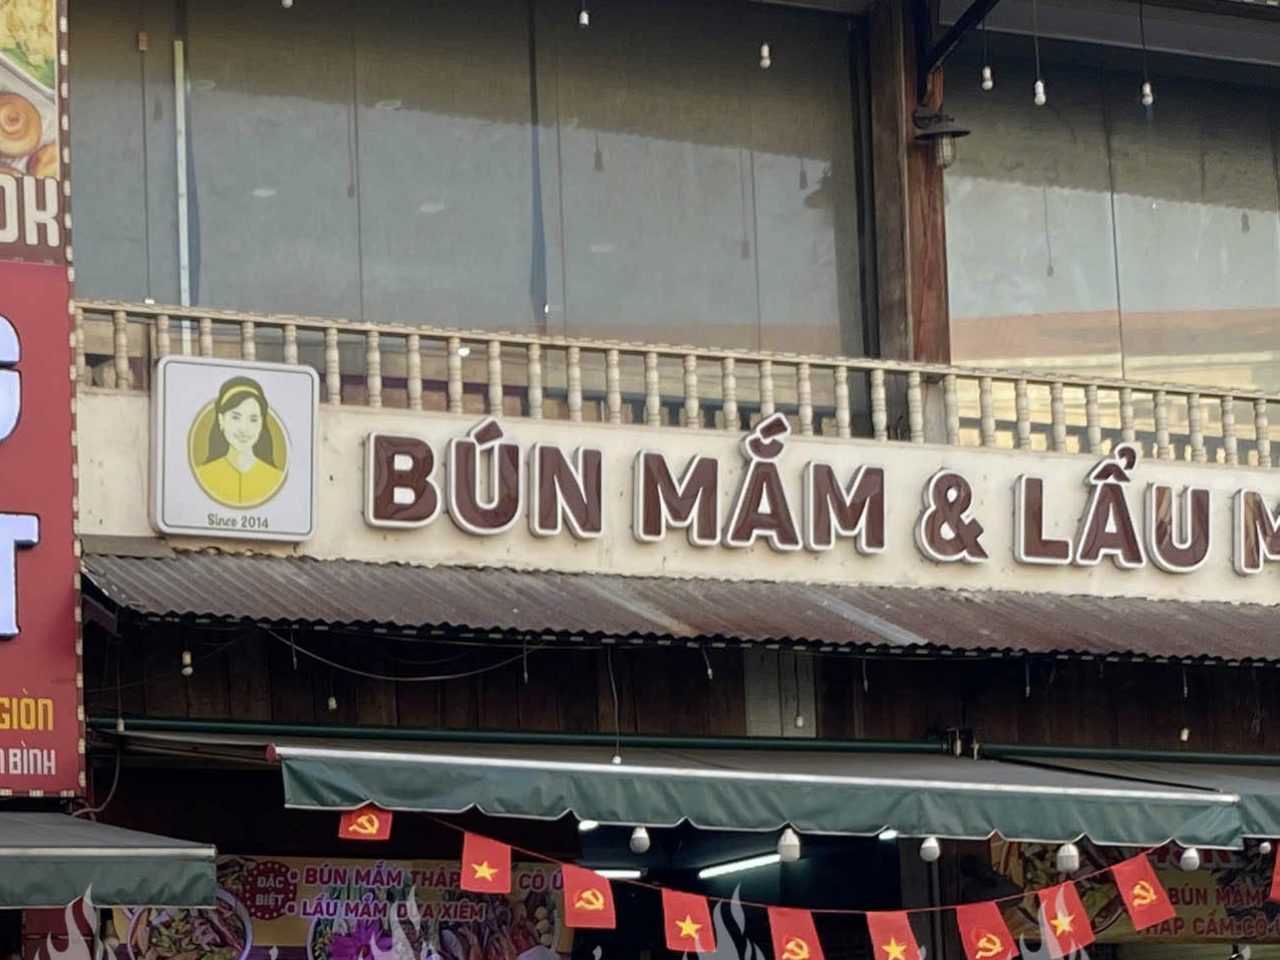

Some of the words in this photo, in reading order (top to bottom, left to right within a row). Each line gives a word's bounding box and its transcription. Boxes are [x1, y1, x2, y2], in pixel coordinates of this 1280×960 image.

[365, 418, 603, 540] BÚN
[632, 410, 886, 555] MẮM
[915, 467, 990, 565] &
[1014, 442, 1213, 575] LẨU
[207, 513, 238, 528] Since
[241, 515, 269, 529] 2014
[8, 740, 57, 775] BÌNH
[304, 864, 348, 885] BÚN
[395, 902, 434, 920] DA
